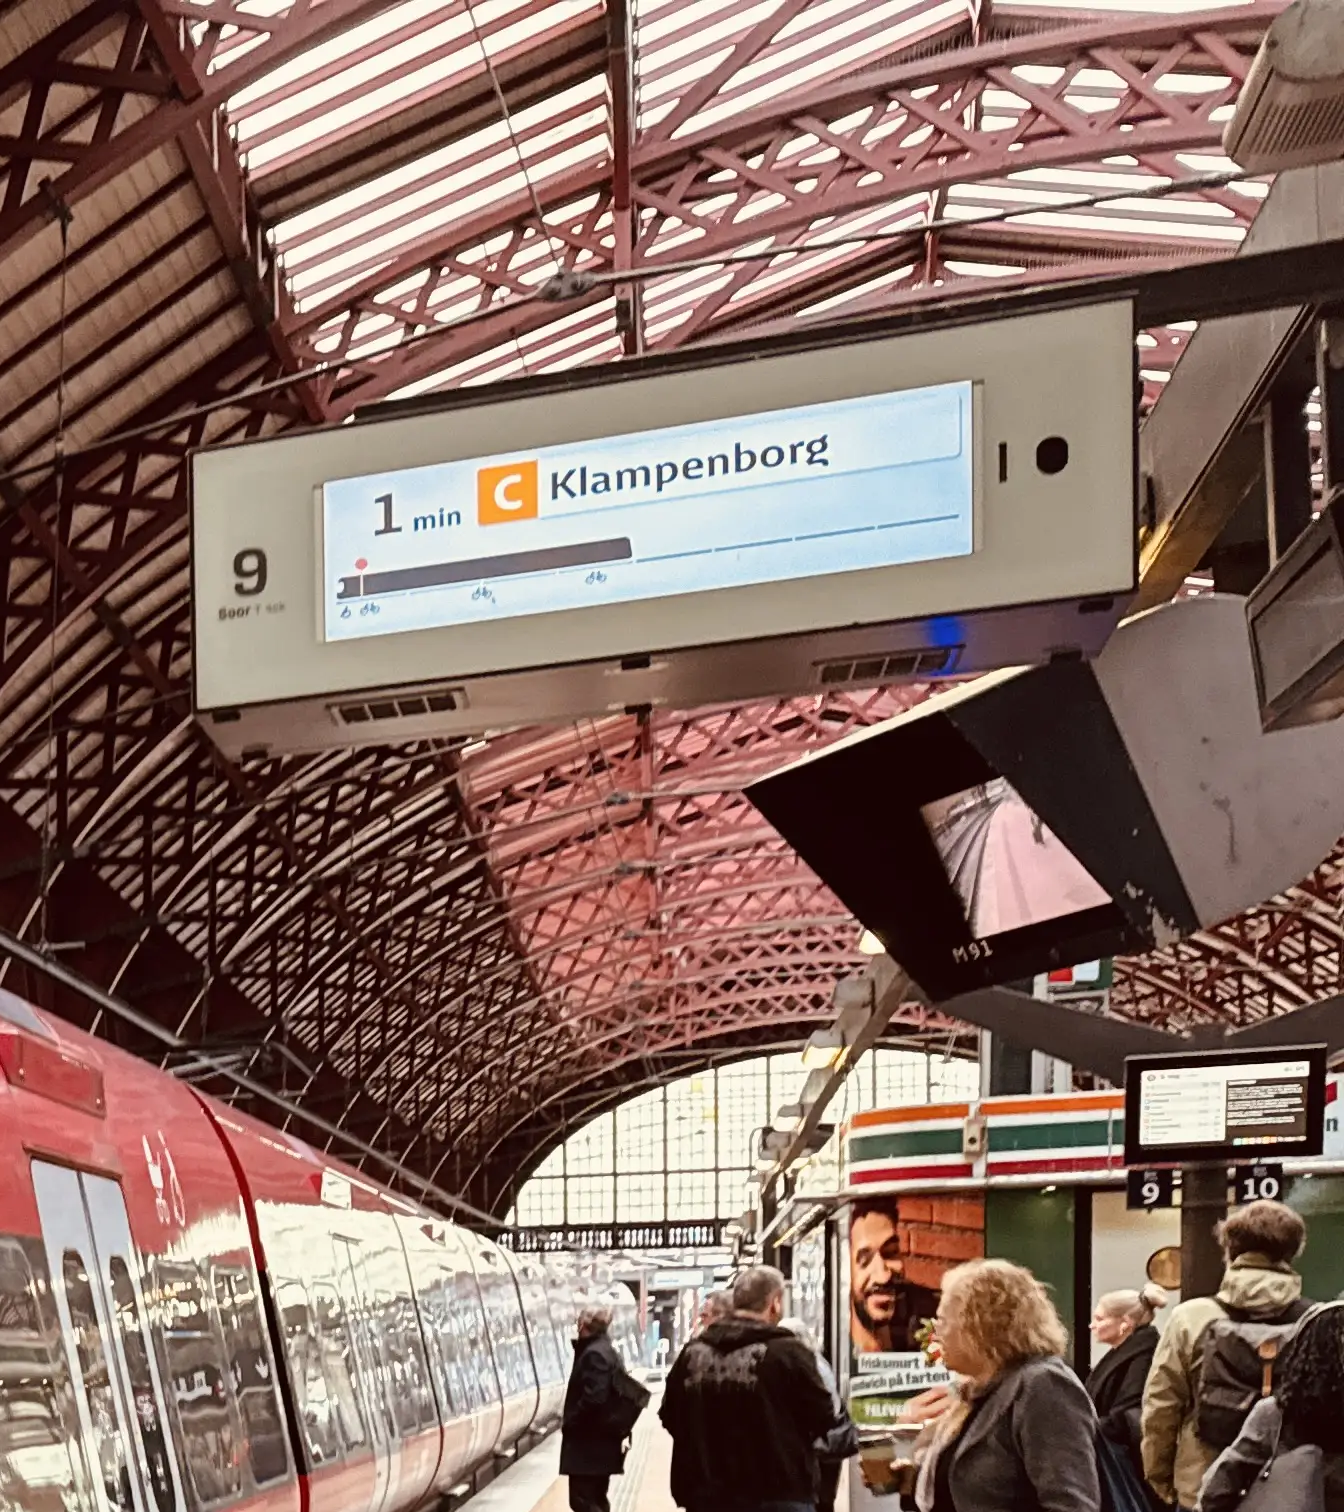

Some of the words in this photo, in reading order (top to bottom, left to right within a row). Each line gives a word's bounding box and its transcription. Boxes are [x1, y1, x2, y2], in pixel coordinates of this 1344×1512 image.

[374, 493, 403, 536] 1
[413, 508, 461, 532] min
[493, 473, 524, 510] C
[551, 434, 830, 500] Klampenborg
[233, 547, 268, 597] 9
[952, 940, 993, 964] M91
[1141, 1182, 1160, 1205] 9
[1243, 1177, 1279, 1200] 10
